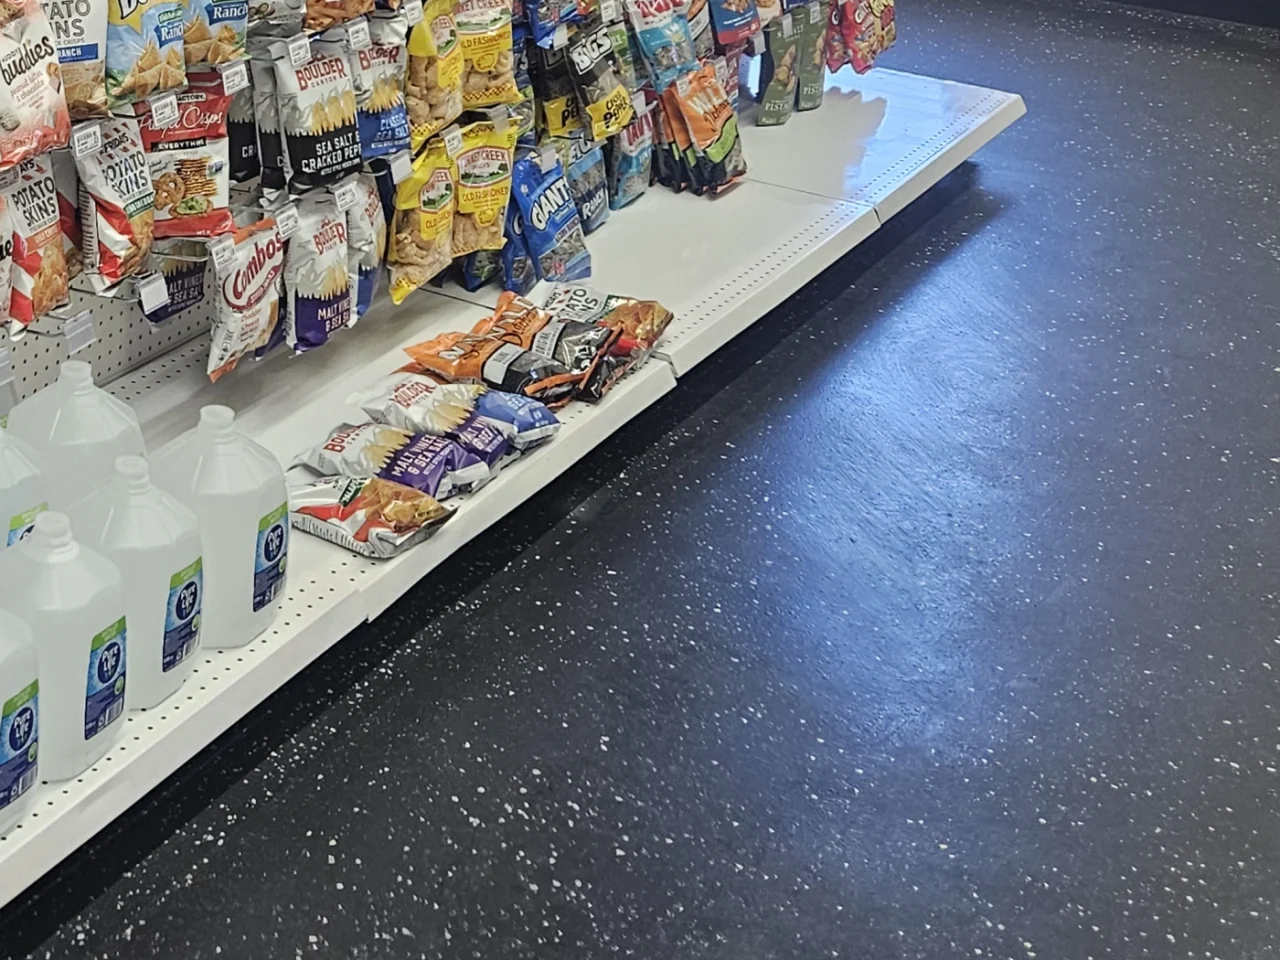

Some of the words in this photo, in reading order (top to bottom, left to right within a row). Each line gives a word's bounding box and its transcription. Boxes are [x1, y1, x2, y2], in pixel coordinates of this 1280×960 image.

[213, 4, 248, 20] Ranch
[570, 25, 612, 71] BIGS
[296, 57, 347, 92] BOULDER
[316, 143, 329, 155] SEA
[331, 136, 352, 153] SALT
[481, 147, 507, 162] CREEK
[101, 150, 147, 181] POTATO
[302, 152, 342, 172] CRACKED
[111, 173, 149, 199] SKINS
[234, 234, 284, 299] Combos
[318, 306, 336, 322] MALT
[392, 448, 411, 477] MALT
[418, 451, 431, 469] SEA
[12, 707, 32, 729] Pure
